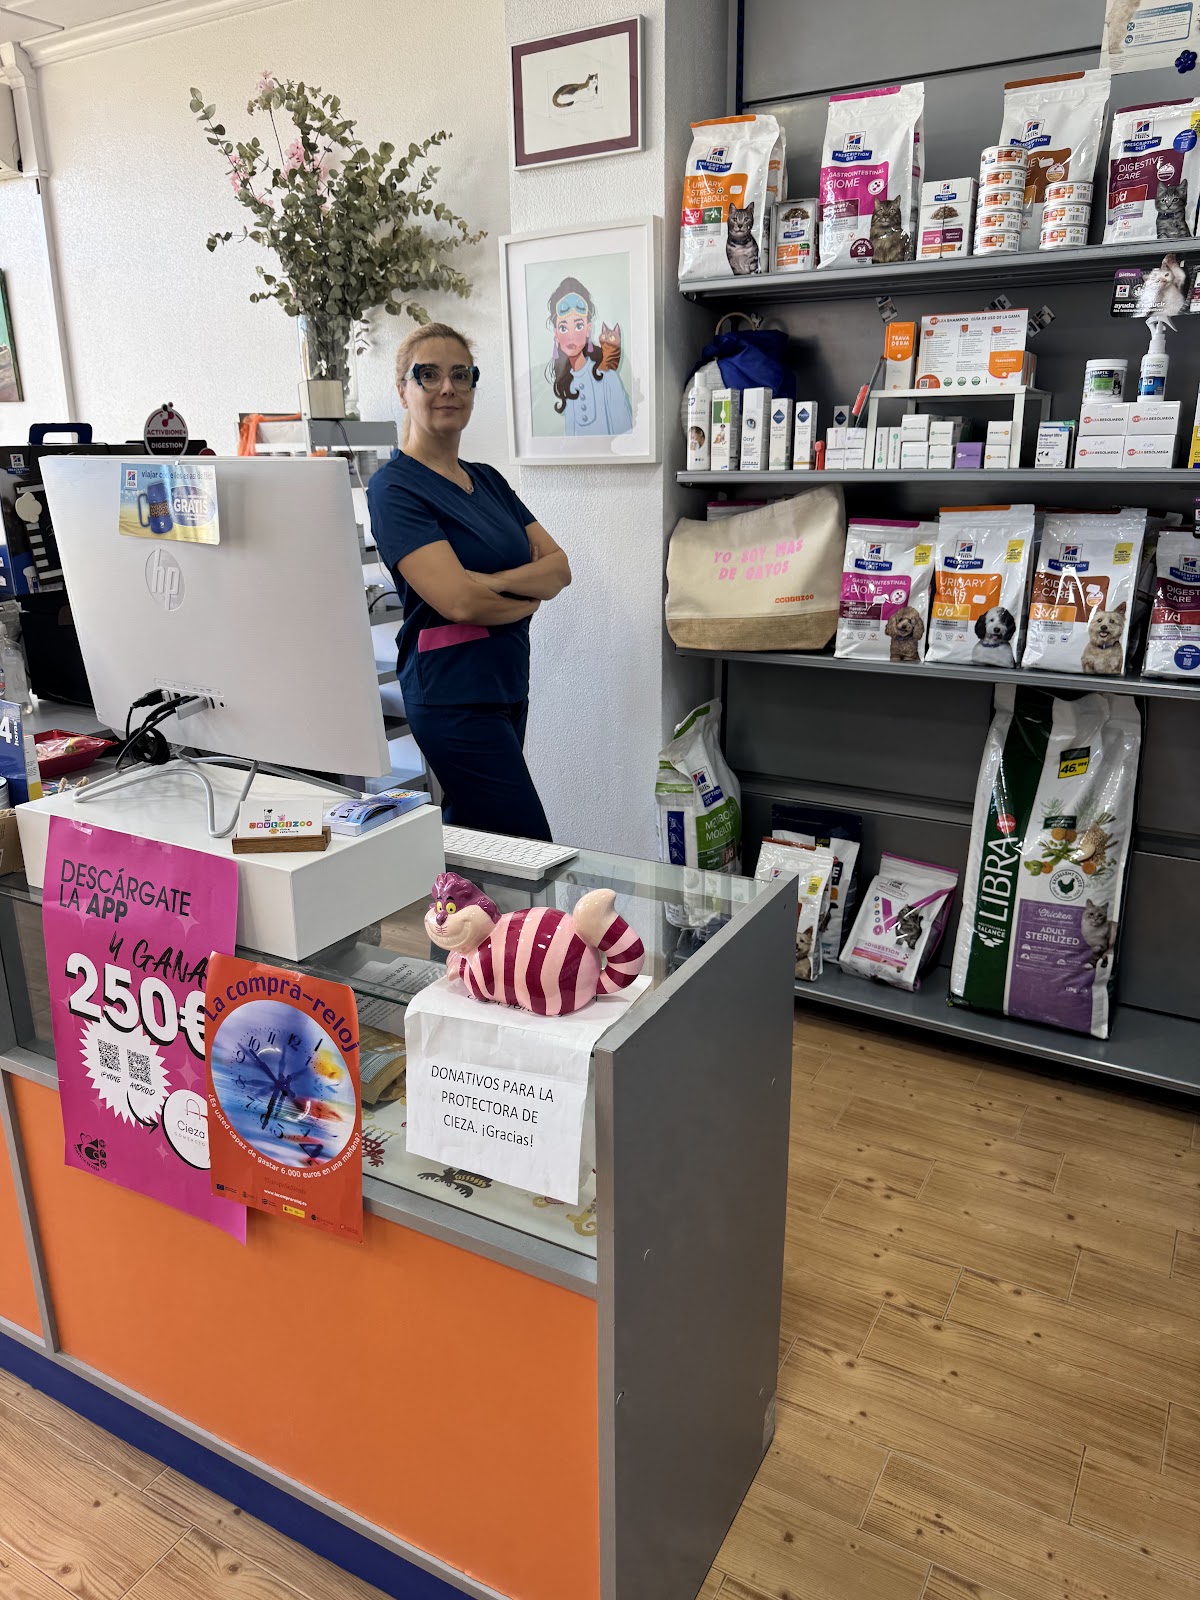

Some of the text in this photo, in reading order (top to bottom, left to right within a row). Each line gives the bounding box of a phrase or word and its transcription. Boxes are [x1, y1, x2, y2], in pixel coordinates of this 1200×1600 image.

[1123, 139, 1160, 149] PRESCRIPTION
[1119, 156, 1164, 173] DIGESTIVE
[828, 169, 885, 179] GASTROINTESTINAL
[1117, 171, 1142, 181] CARE
[692, 180, 723, 192] URINARY
[689, 195, 729, 205] METABOLIC
[690, 189, 716, 199] STRESS
[1113, 301, 1136, 312] ayuda
[142, 471, 158, 480] viajar
[173, 498, 208, 514] GRATIS
[714, 551, 733, 564] YO
[741, 546, 767, 564] SOY
[719, 560, 789, 581] DE GATOS
[857, 560, 891, 569] PRESCRIPTION
[153, 552, 179, 609] hp
[852, 577, 907, 586] GASTROINTESTINAL
[939, 575, 986, 588] URINARY
[850, 584, 884, 595] BIOME
[1041, 586, 1071, 598] CARE
[1167, 592, 1192, 603] CARE
[937, 606, 953, 619] c/d
[1164, 610, 1181, 622] i/d
[978, 836, 1019, 923] LIBRA
[1052, 871, 1083, 888] EXCELLENT TASTE
[60, 859, 192, 917] DESCÁRGATE
[59, 884, 128, 923] LA APP
[1039, 908, 1072, 920] Chicken
[977, 925, 1006, 939] BALANCE
[1025, 931, 1081, 946] STERILIZED
[1040, 926, 1067, 937] ADULT
[132, 938, 208, 990] GANA
[65, 952, 206, 1061] 250€
[203, 976, 359, 1053] La compra-reloj
[248, 1036, 261, 1052] 10
[431, 1065, 554, 1103] DONATIVOS PARA LA
[441, 1090, 539, 1124] PROTECTORA DE
[177, 1120, 205, 1139] Cieza
[443, 1114, 534, 1148] CIEZA. ¡Gracias!
[208, 1094, 362, 1180] ¿Es usted capaz de gastar 6.000 euros en una mañana?
